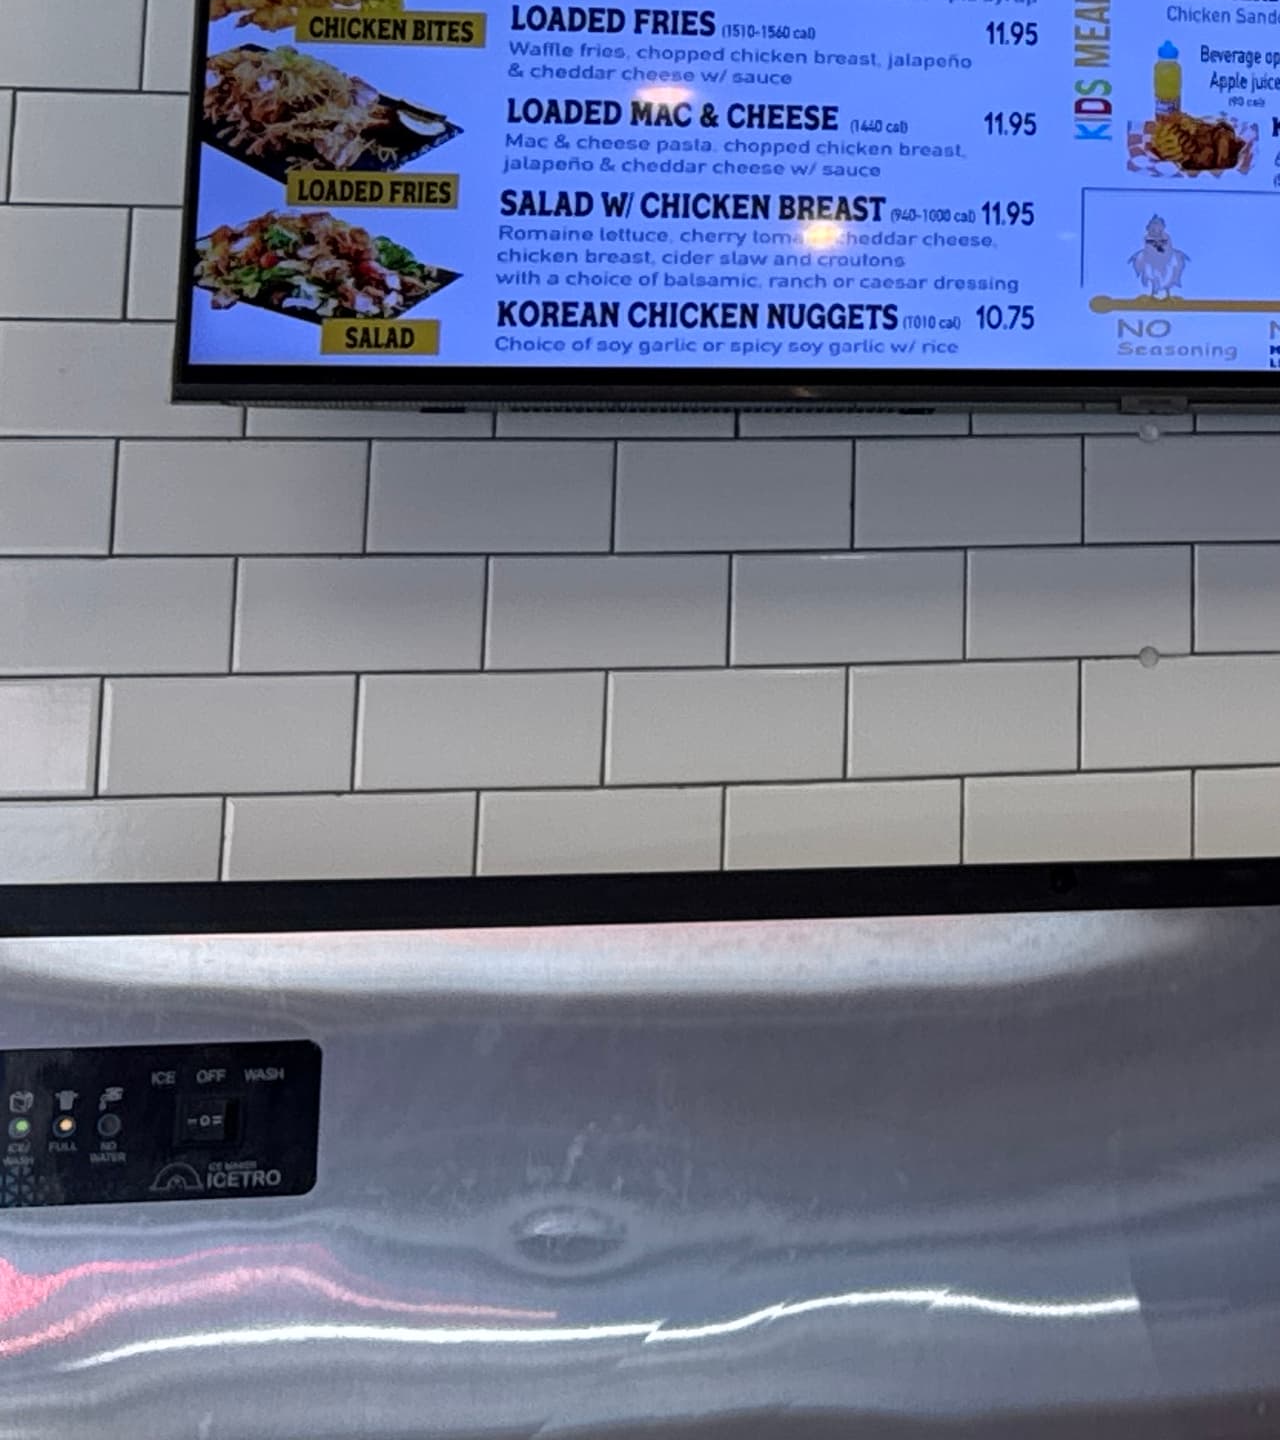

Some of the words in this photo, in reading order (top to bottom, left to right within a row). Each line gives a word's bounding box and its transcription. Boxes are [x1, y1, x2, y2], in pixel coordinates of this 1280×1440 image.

[306, 16, 407, 45] CHICKEN
[411, 20, 473, 47] BITES
[511, 5, 625, 33] LOADED
[634, 9, 715, 36] FRIES
[986, 22, 1037, 46] 11.95
[508, 98, 621, 125] LOADED
[630, 97, 691, 127] MAC
[700, 103, 718, 128] &
[728, 103, 838, 130] CHEESE
[984, 112, 1036, 135] 11.95
[1074, 79, 1112, 141] KIDS
[298, 179, 383, 202] LOADED
[390, 181, 453, 209] FRIES
[501, 189, 593, 216] SALAD
[601, 192, 633, 218] W/
[641, 192, 770, 219] CHICKEN
[779, 195, 886, 226] BREAST
[982, 201, 1034, 226] 11.95
[498, 300, 620, 327] KOREAN
[628, 302, 759, 328] CHICKEN
[767, 303, 898, 330] NUGGETS
[976, 305, 1034, 329] 10.75
[346, 327, 414, 348] SALAD
[151, 1071, 176, 1086] ICE
[196, 1069, 227, 1084] OFF
[244, 1068, 285, 1082] WASH
[207, 1169, 281, 1189] ICETRO
